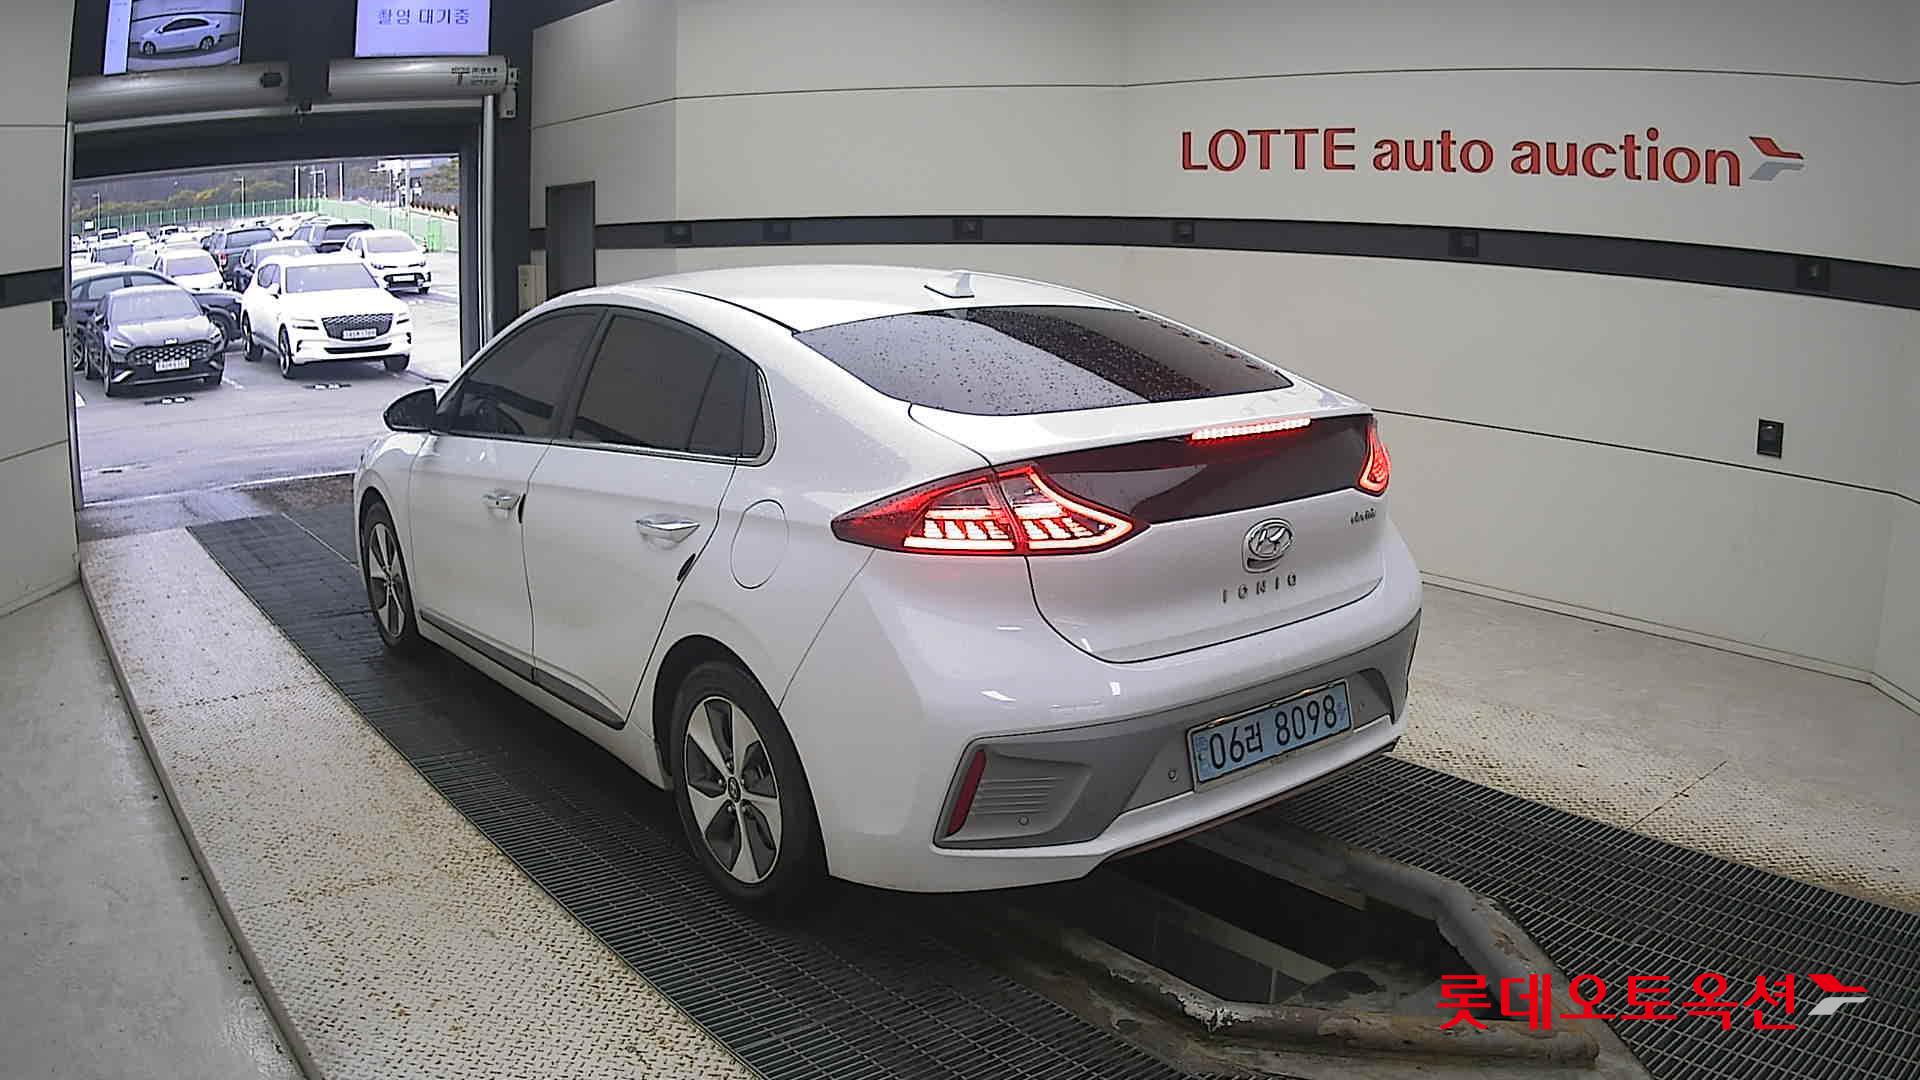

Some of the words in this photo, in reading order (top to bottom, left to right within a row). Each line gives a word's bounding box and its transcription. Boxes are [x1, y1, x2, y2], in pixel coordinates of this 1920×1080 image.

[419, 8, 470, 25] 대기중
[1182, 128, 1356, 171] LOTTE
[1372, 129, 1495, 173] auto
[1511, 128, 1741, 186] auction
[1222, 574, 1297, 604] IONIQ
[1208, 720, 1264, 770] 06러
[1274, 694, 1338, 747] 8098
